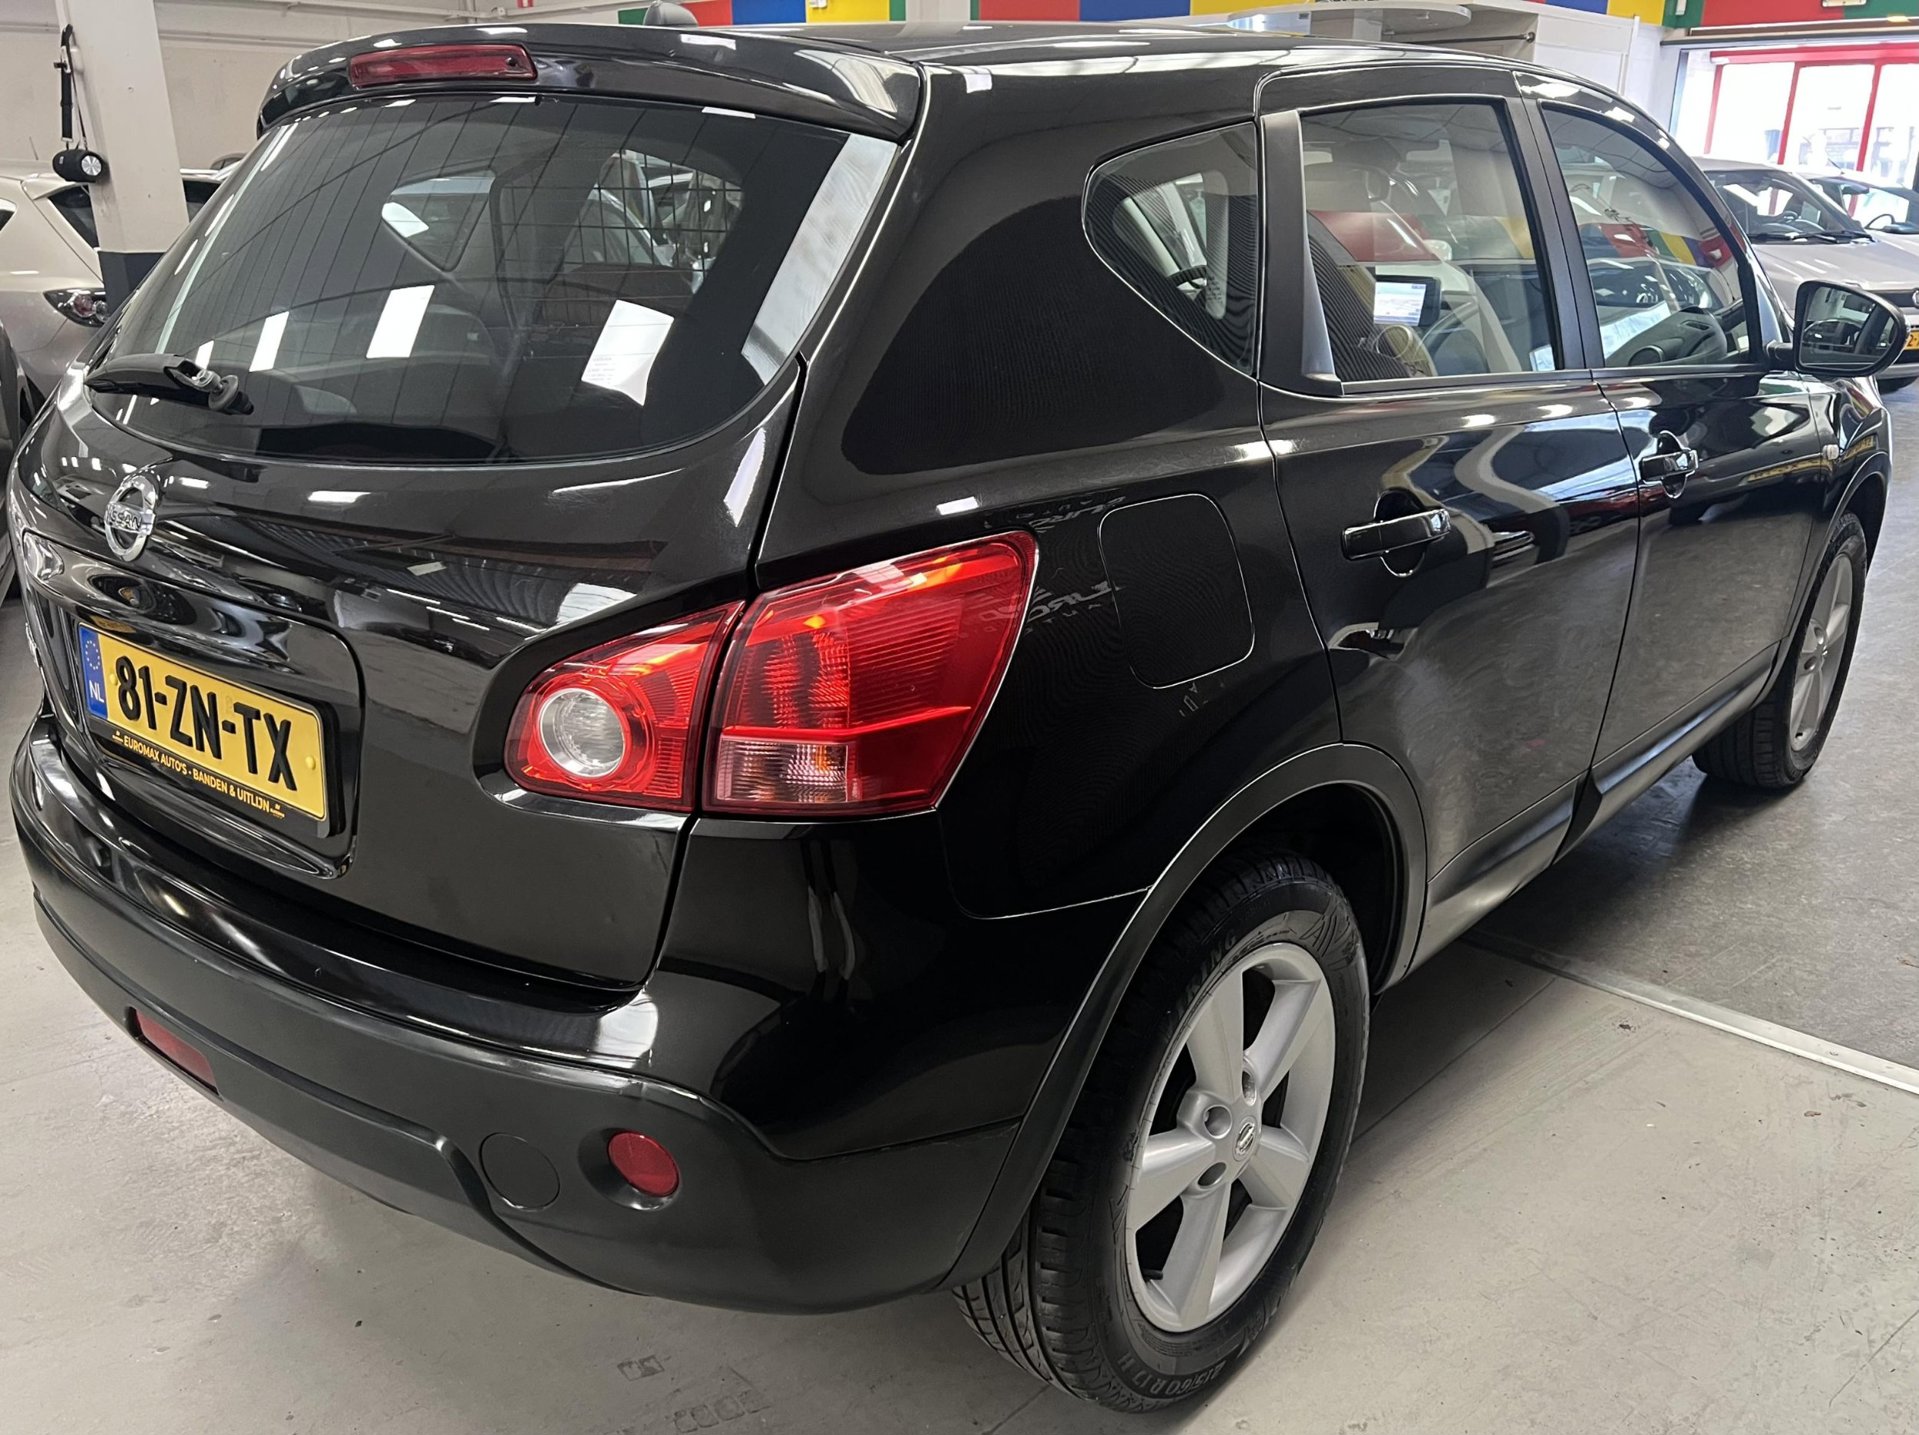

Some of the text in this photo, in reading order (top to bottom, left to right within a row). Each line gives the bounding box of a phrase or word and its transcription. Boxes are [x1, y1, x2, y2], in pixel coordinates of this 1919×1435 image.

[89, 680, 104, 703] NL
[116, 655, 298, 791] 81-ZN-TX
[124, 735, 160, 762] EUROMAX
[161, 754, 187, 775] AUTO'S
[192, 768, 228, 794] BANDEN
[229, 785, 236, 797] &
[237, 787, 270, 813] UITLIJN
